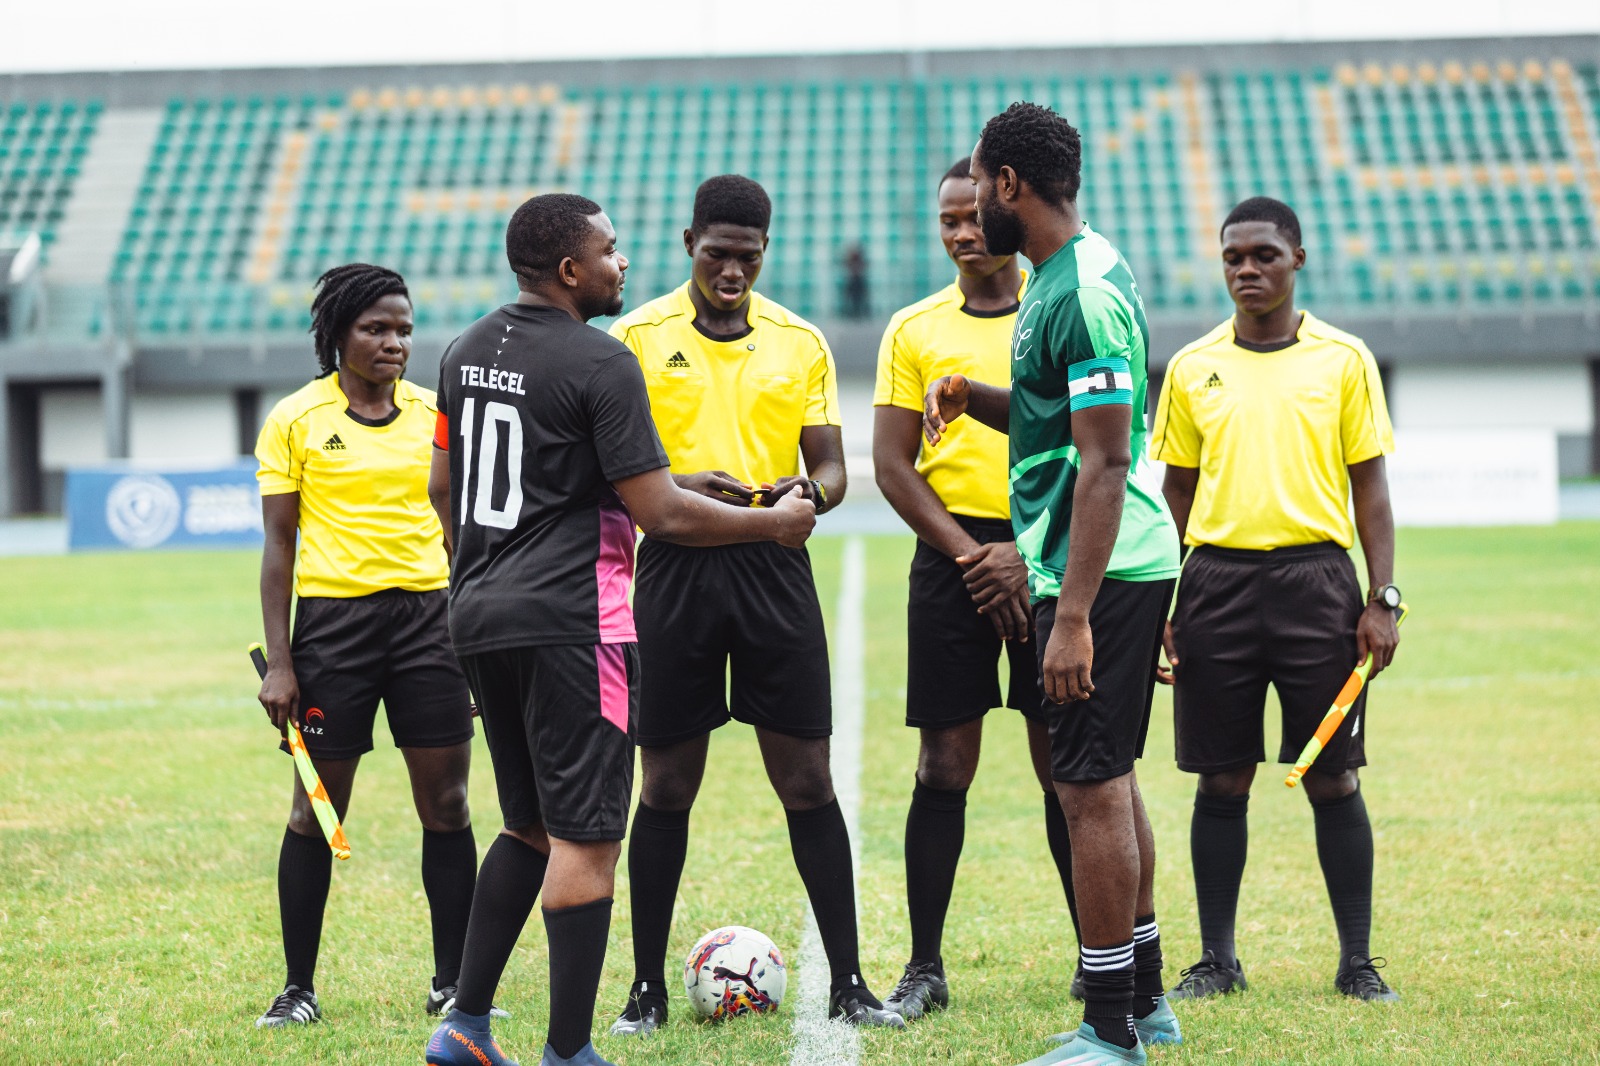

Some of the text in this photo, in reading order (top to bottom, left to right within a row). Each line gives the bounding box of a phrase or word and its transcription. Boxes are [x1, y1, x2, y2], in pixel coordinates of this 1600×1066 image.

[665, 360, 691, 368] adidas
[460, 365, 527, 396] TELECEL
[460, 397, 524, 530] 10
[303, 725, 324, 735] ZAZ
